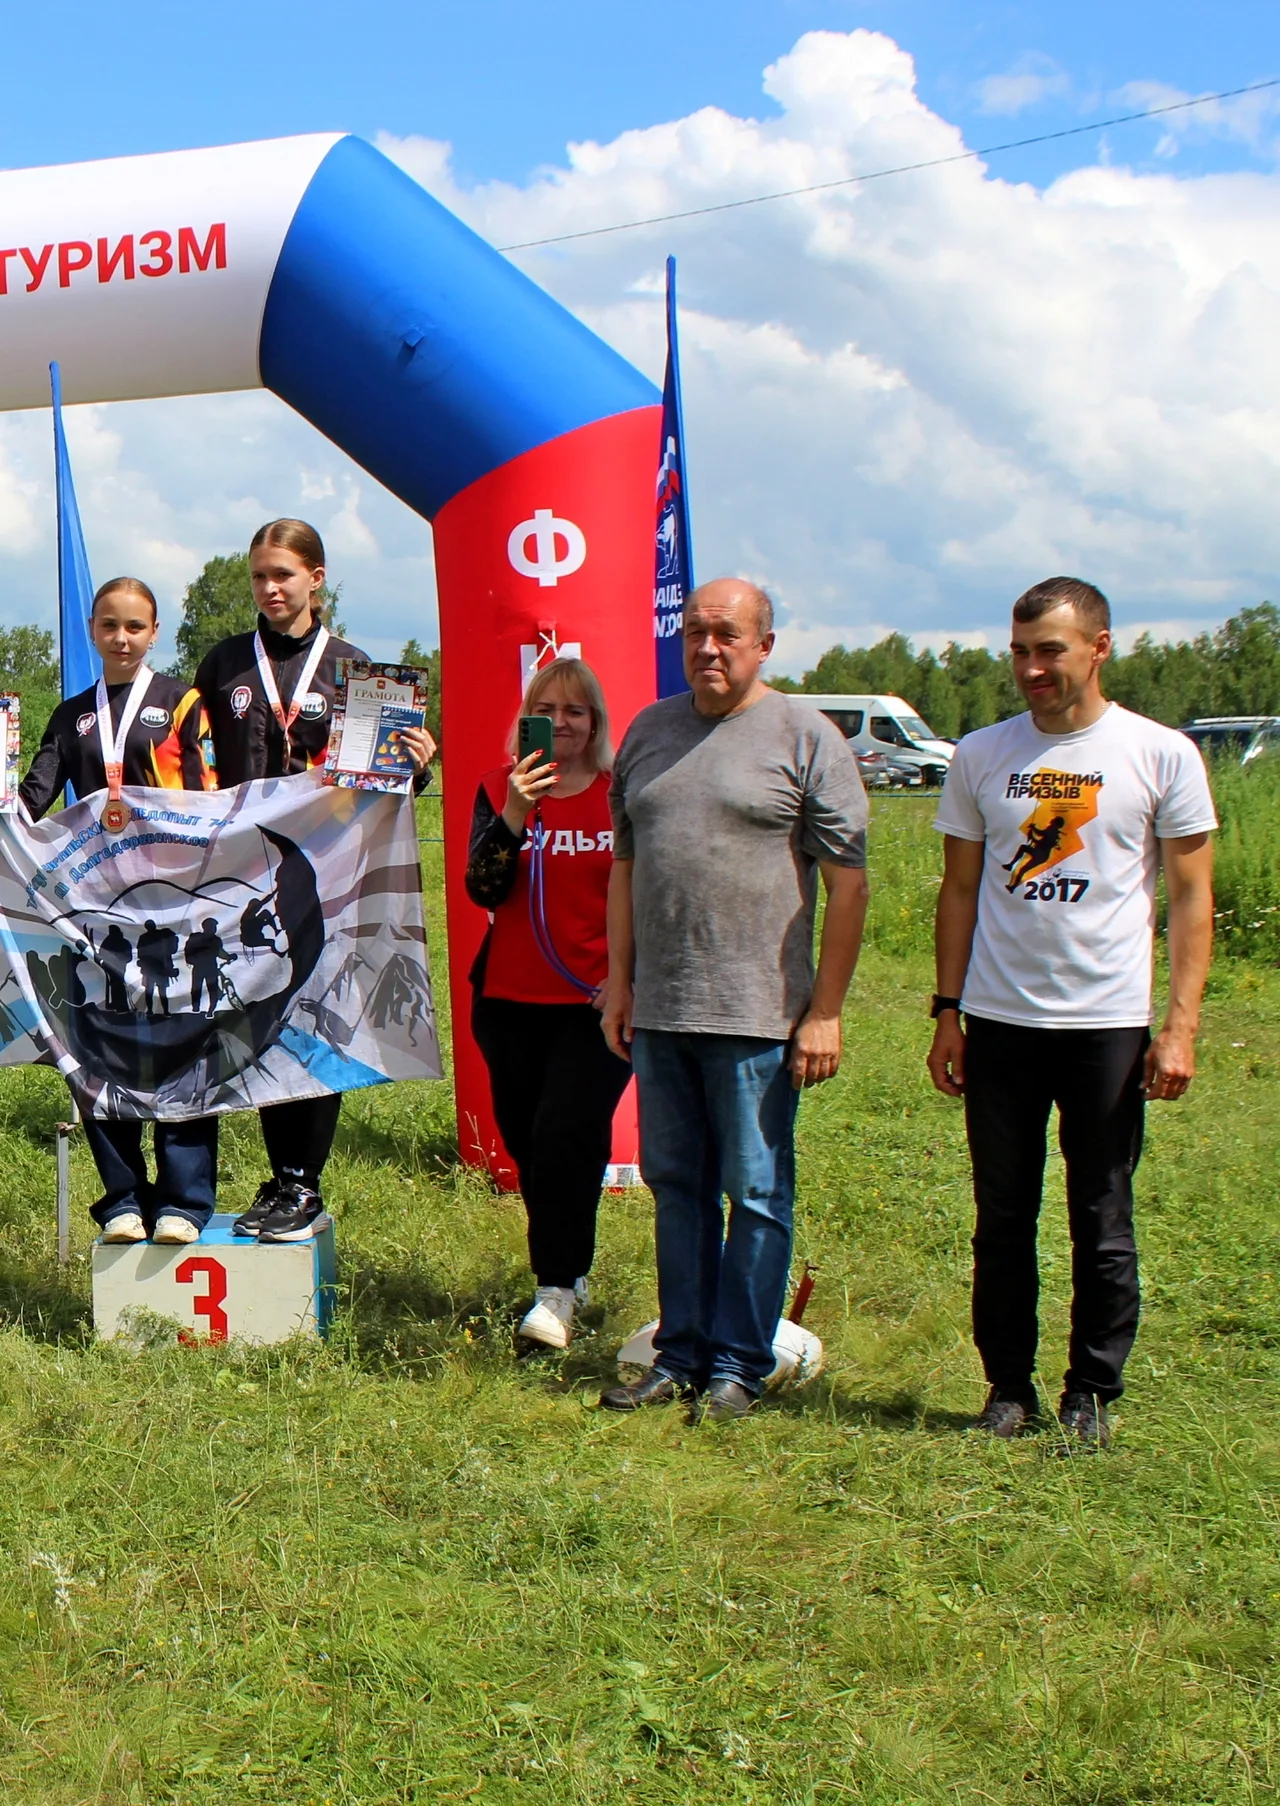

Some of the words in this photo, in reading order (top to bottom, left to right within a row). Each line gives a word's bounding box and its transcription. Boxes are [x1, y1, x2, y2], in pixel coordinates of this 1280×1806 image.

[354, 689, 406, 702] ГРАМОТА
[1008, 770, 1105, 787] ВЕСЕННИЙ
[1005, 786, 1081, 799] ПРИЗЫВ
[520, 827, 614, 856] СУДЬЯ
[69, 831, 210, 884] Долгодеревенское
[1023, 877, 1090, 903] 2017
[175, 1256, 228, 1347] 3
